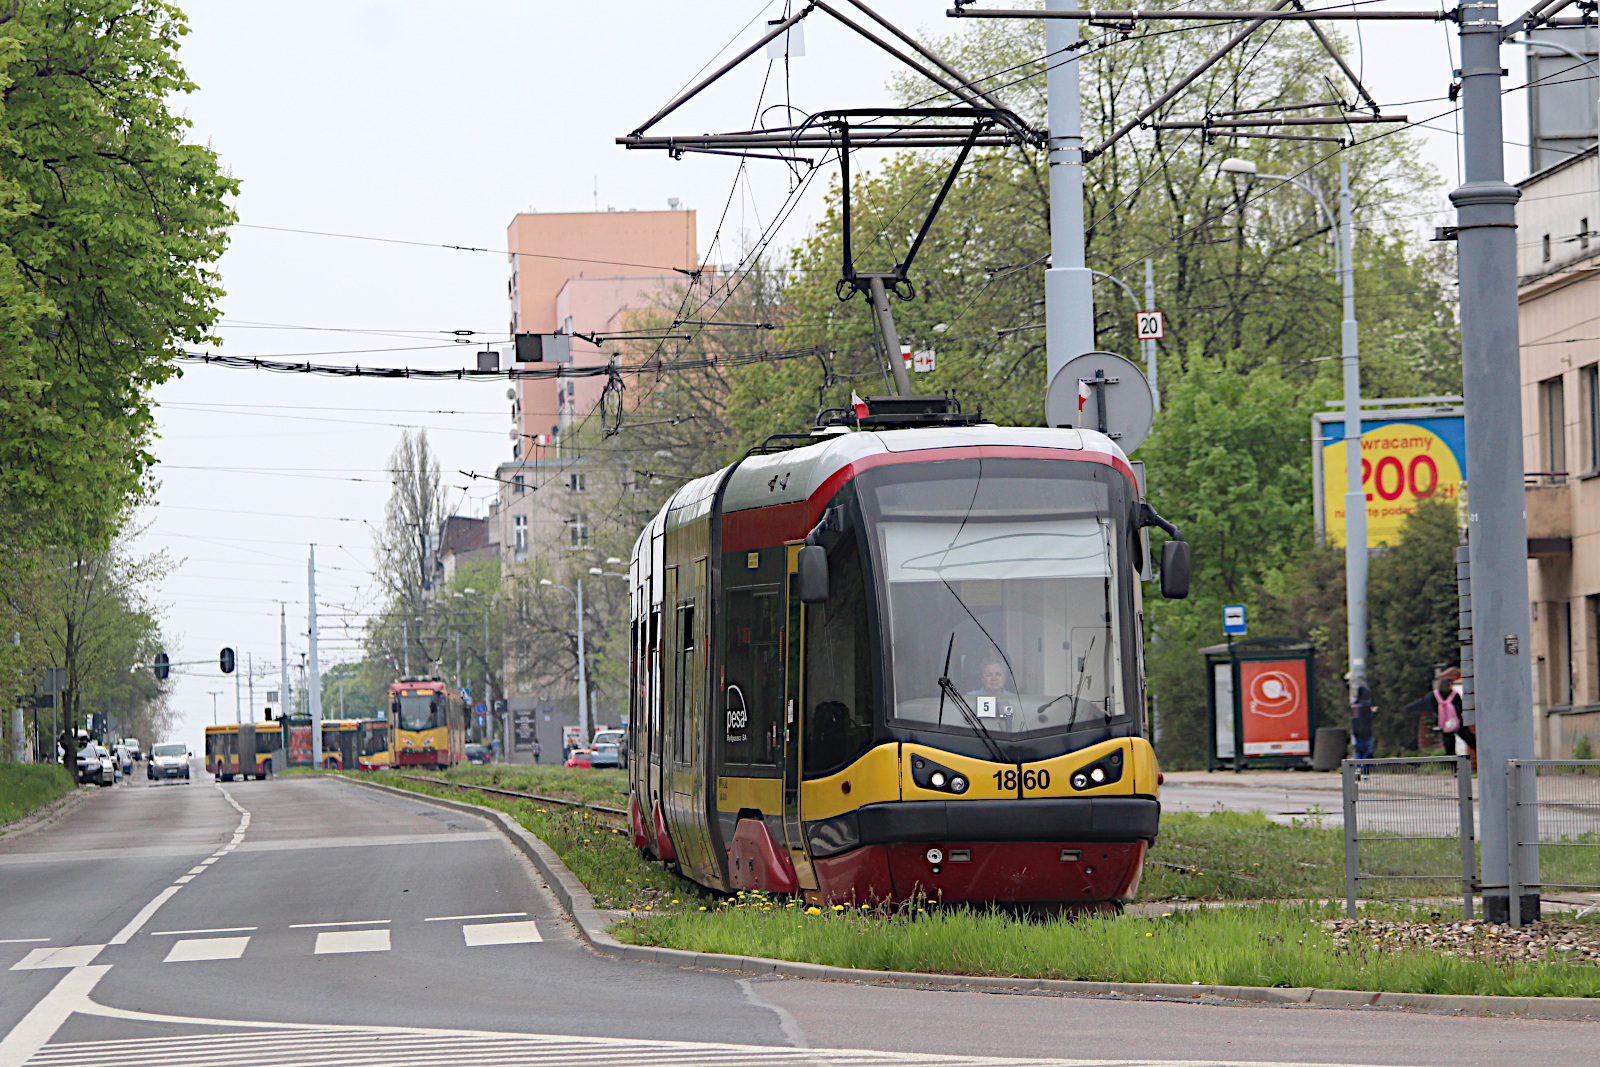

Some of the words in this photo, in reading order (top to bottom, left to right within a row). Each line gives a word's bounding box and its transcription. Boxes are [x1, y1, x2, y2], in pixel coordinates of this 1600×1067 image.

[1141, 317, 1157, 334] 20
[983, 701, 990, 712] 5
[727, 711, 747, 734] pesa
[993, 769, 1050, 790] 1860
